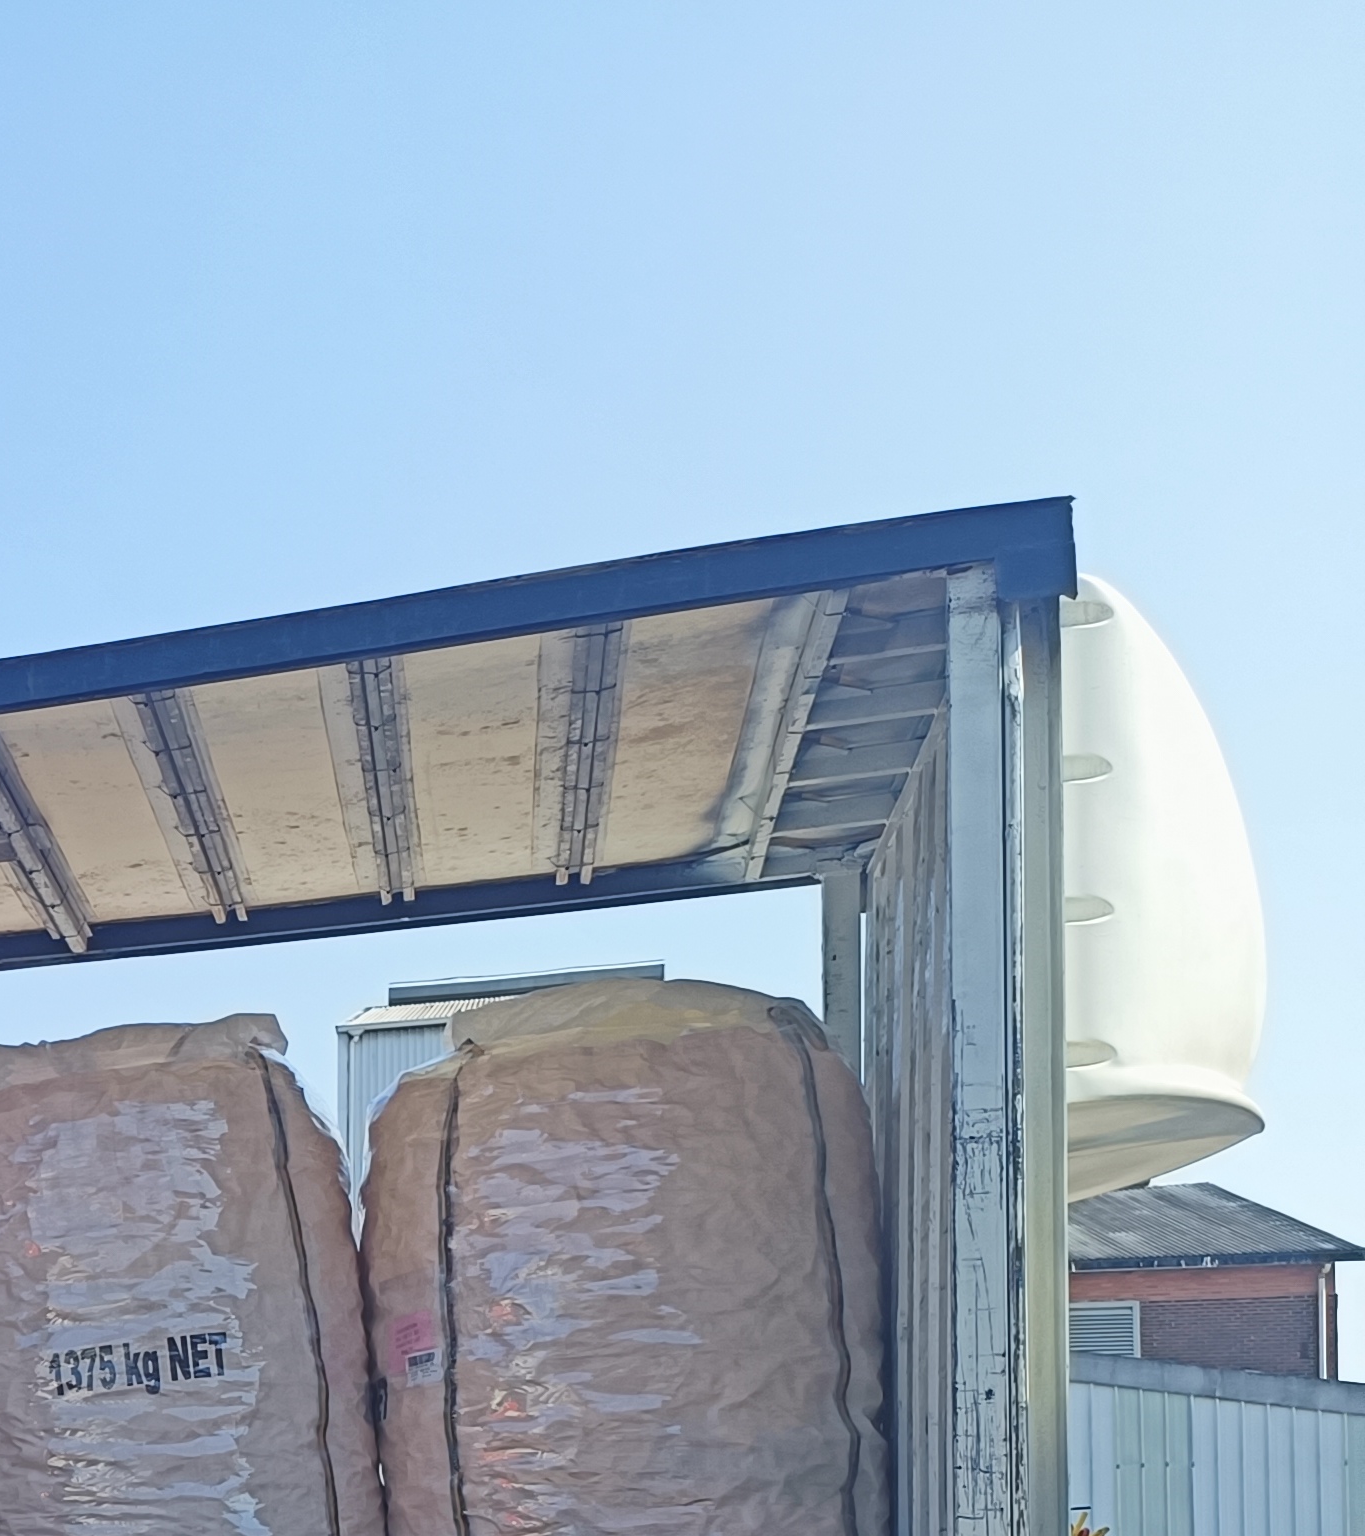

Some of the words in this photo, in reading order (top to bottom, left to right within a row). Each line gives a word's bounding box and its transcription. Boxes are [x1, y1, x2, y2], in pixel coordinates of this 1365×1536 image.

[49, 1345, 117, 1396] 1375
[123, 1343, 161, 1395] kg
[167, 1332, 227, 1382] NET
